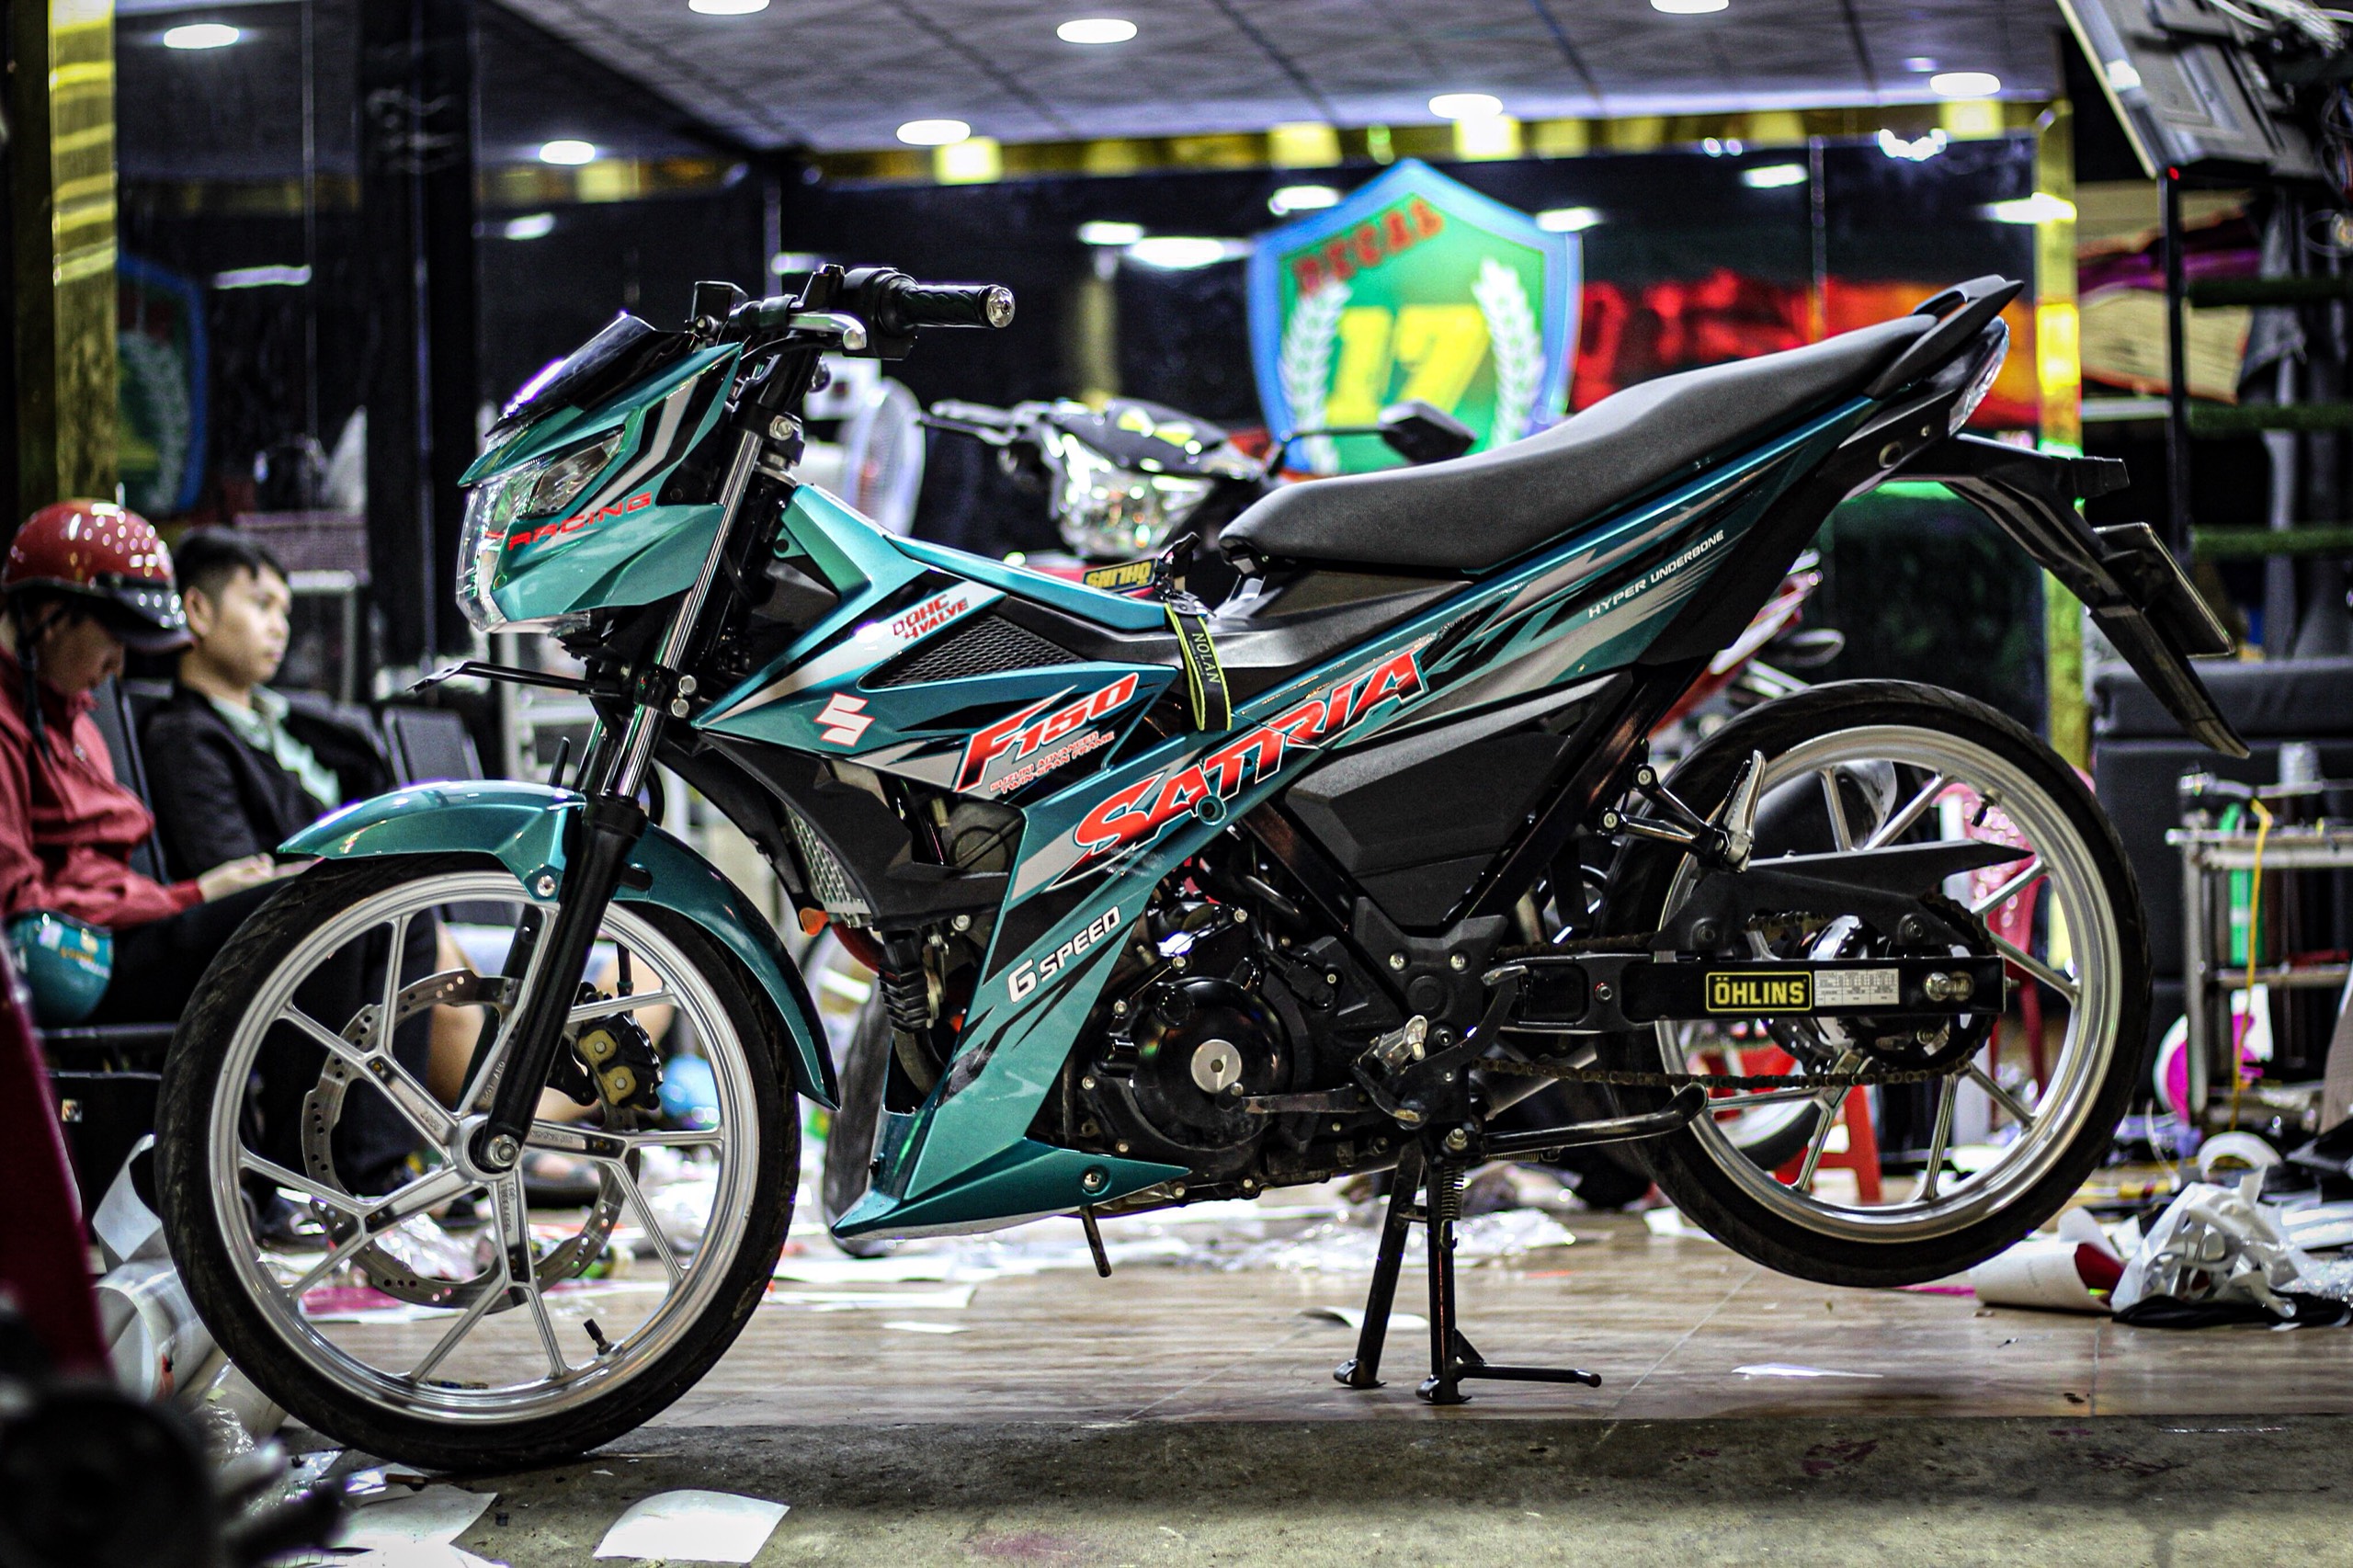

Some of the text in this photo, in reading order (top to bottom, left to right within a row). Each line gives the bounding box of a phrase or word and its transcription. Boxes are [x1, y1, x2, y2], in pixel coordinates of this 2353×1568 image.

[1325, 304, 1490, 426] 17
[1588, 529, 1724, 619] HYPER UNDERBONE
[892, 593, 949, 636] DOHC
[1192, 632, 1222, 684] NOLAN
[956, 672, 1140, 792] F150
[990, 731, 1099, 792] SUZUKI ADVANCED
[1070, 648, 1427, 859] SATRIA
[1072, 731, 1115, 760] FRAME
[1039, 904, 1121, 983] SPEED
[1714, 977, 1806, 1005] ÖHLINS
